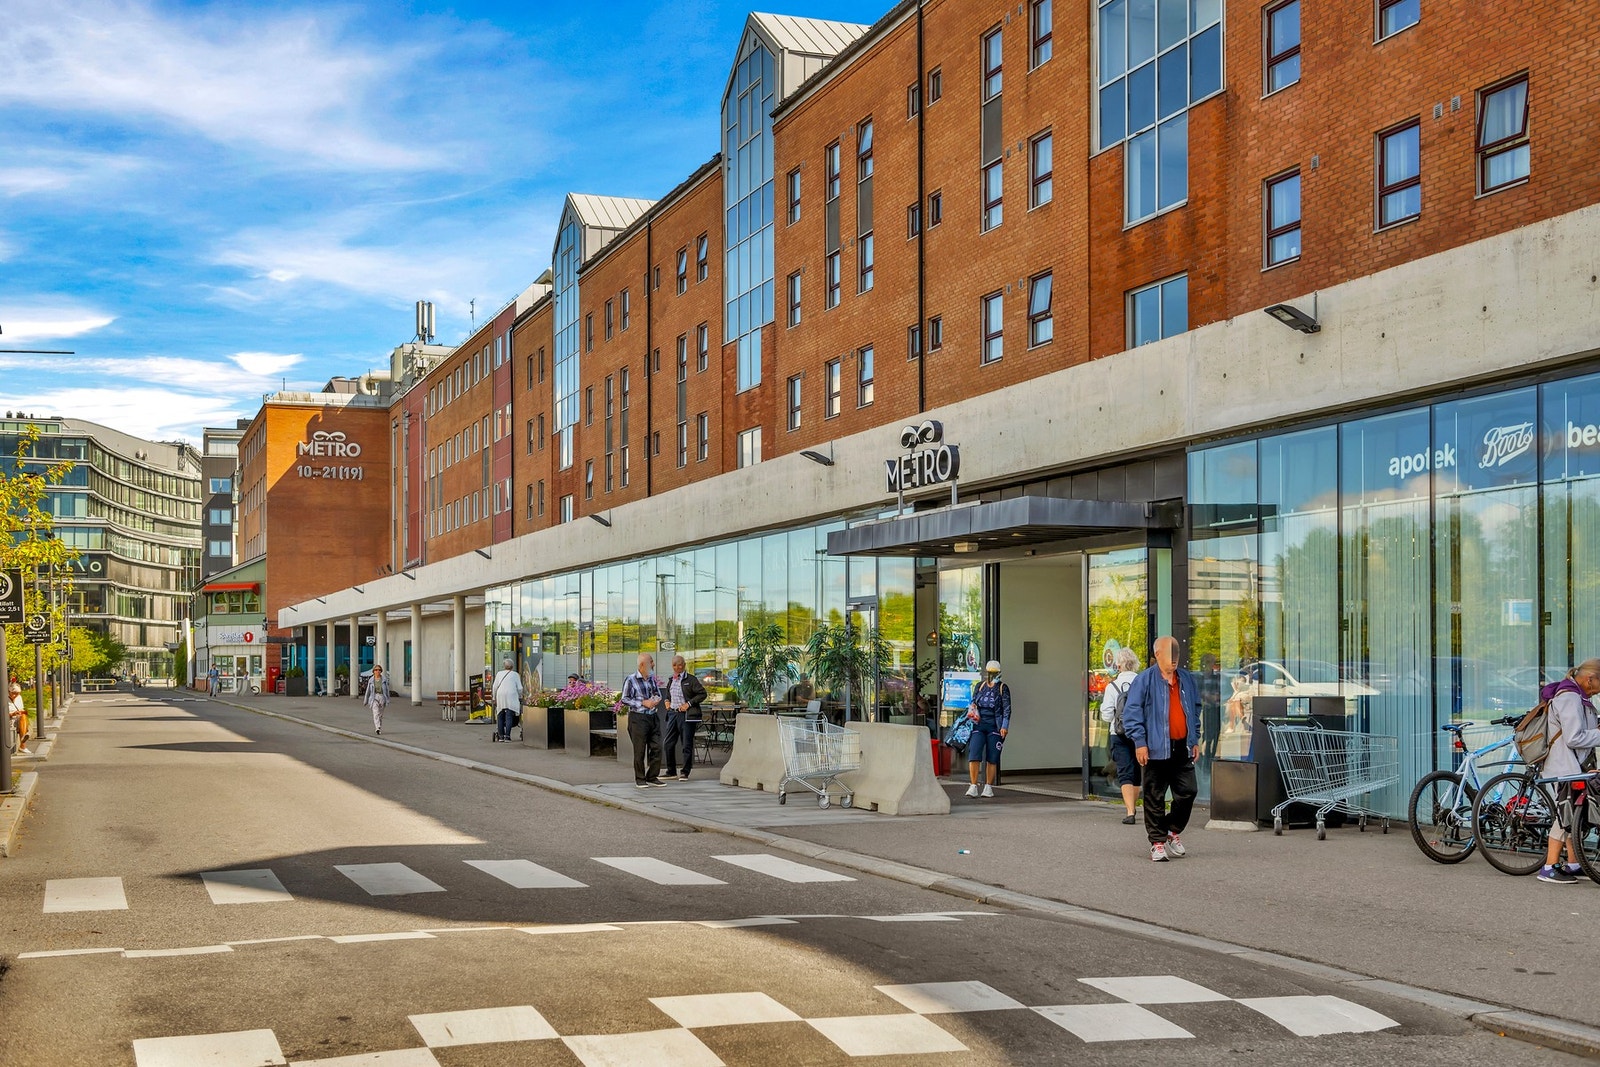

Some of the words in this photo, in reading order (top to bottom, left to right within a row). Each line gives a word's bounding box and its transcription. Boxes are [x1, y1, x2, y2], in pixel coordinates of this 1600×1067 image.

[298, 440, 361, 457] METRO
[1479, 421, 1533, 468] Boots
[886, 445, 959, 492] METRO
